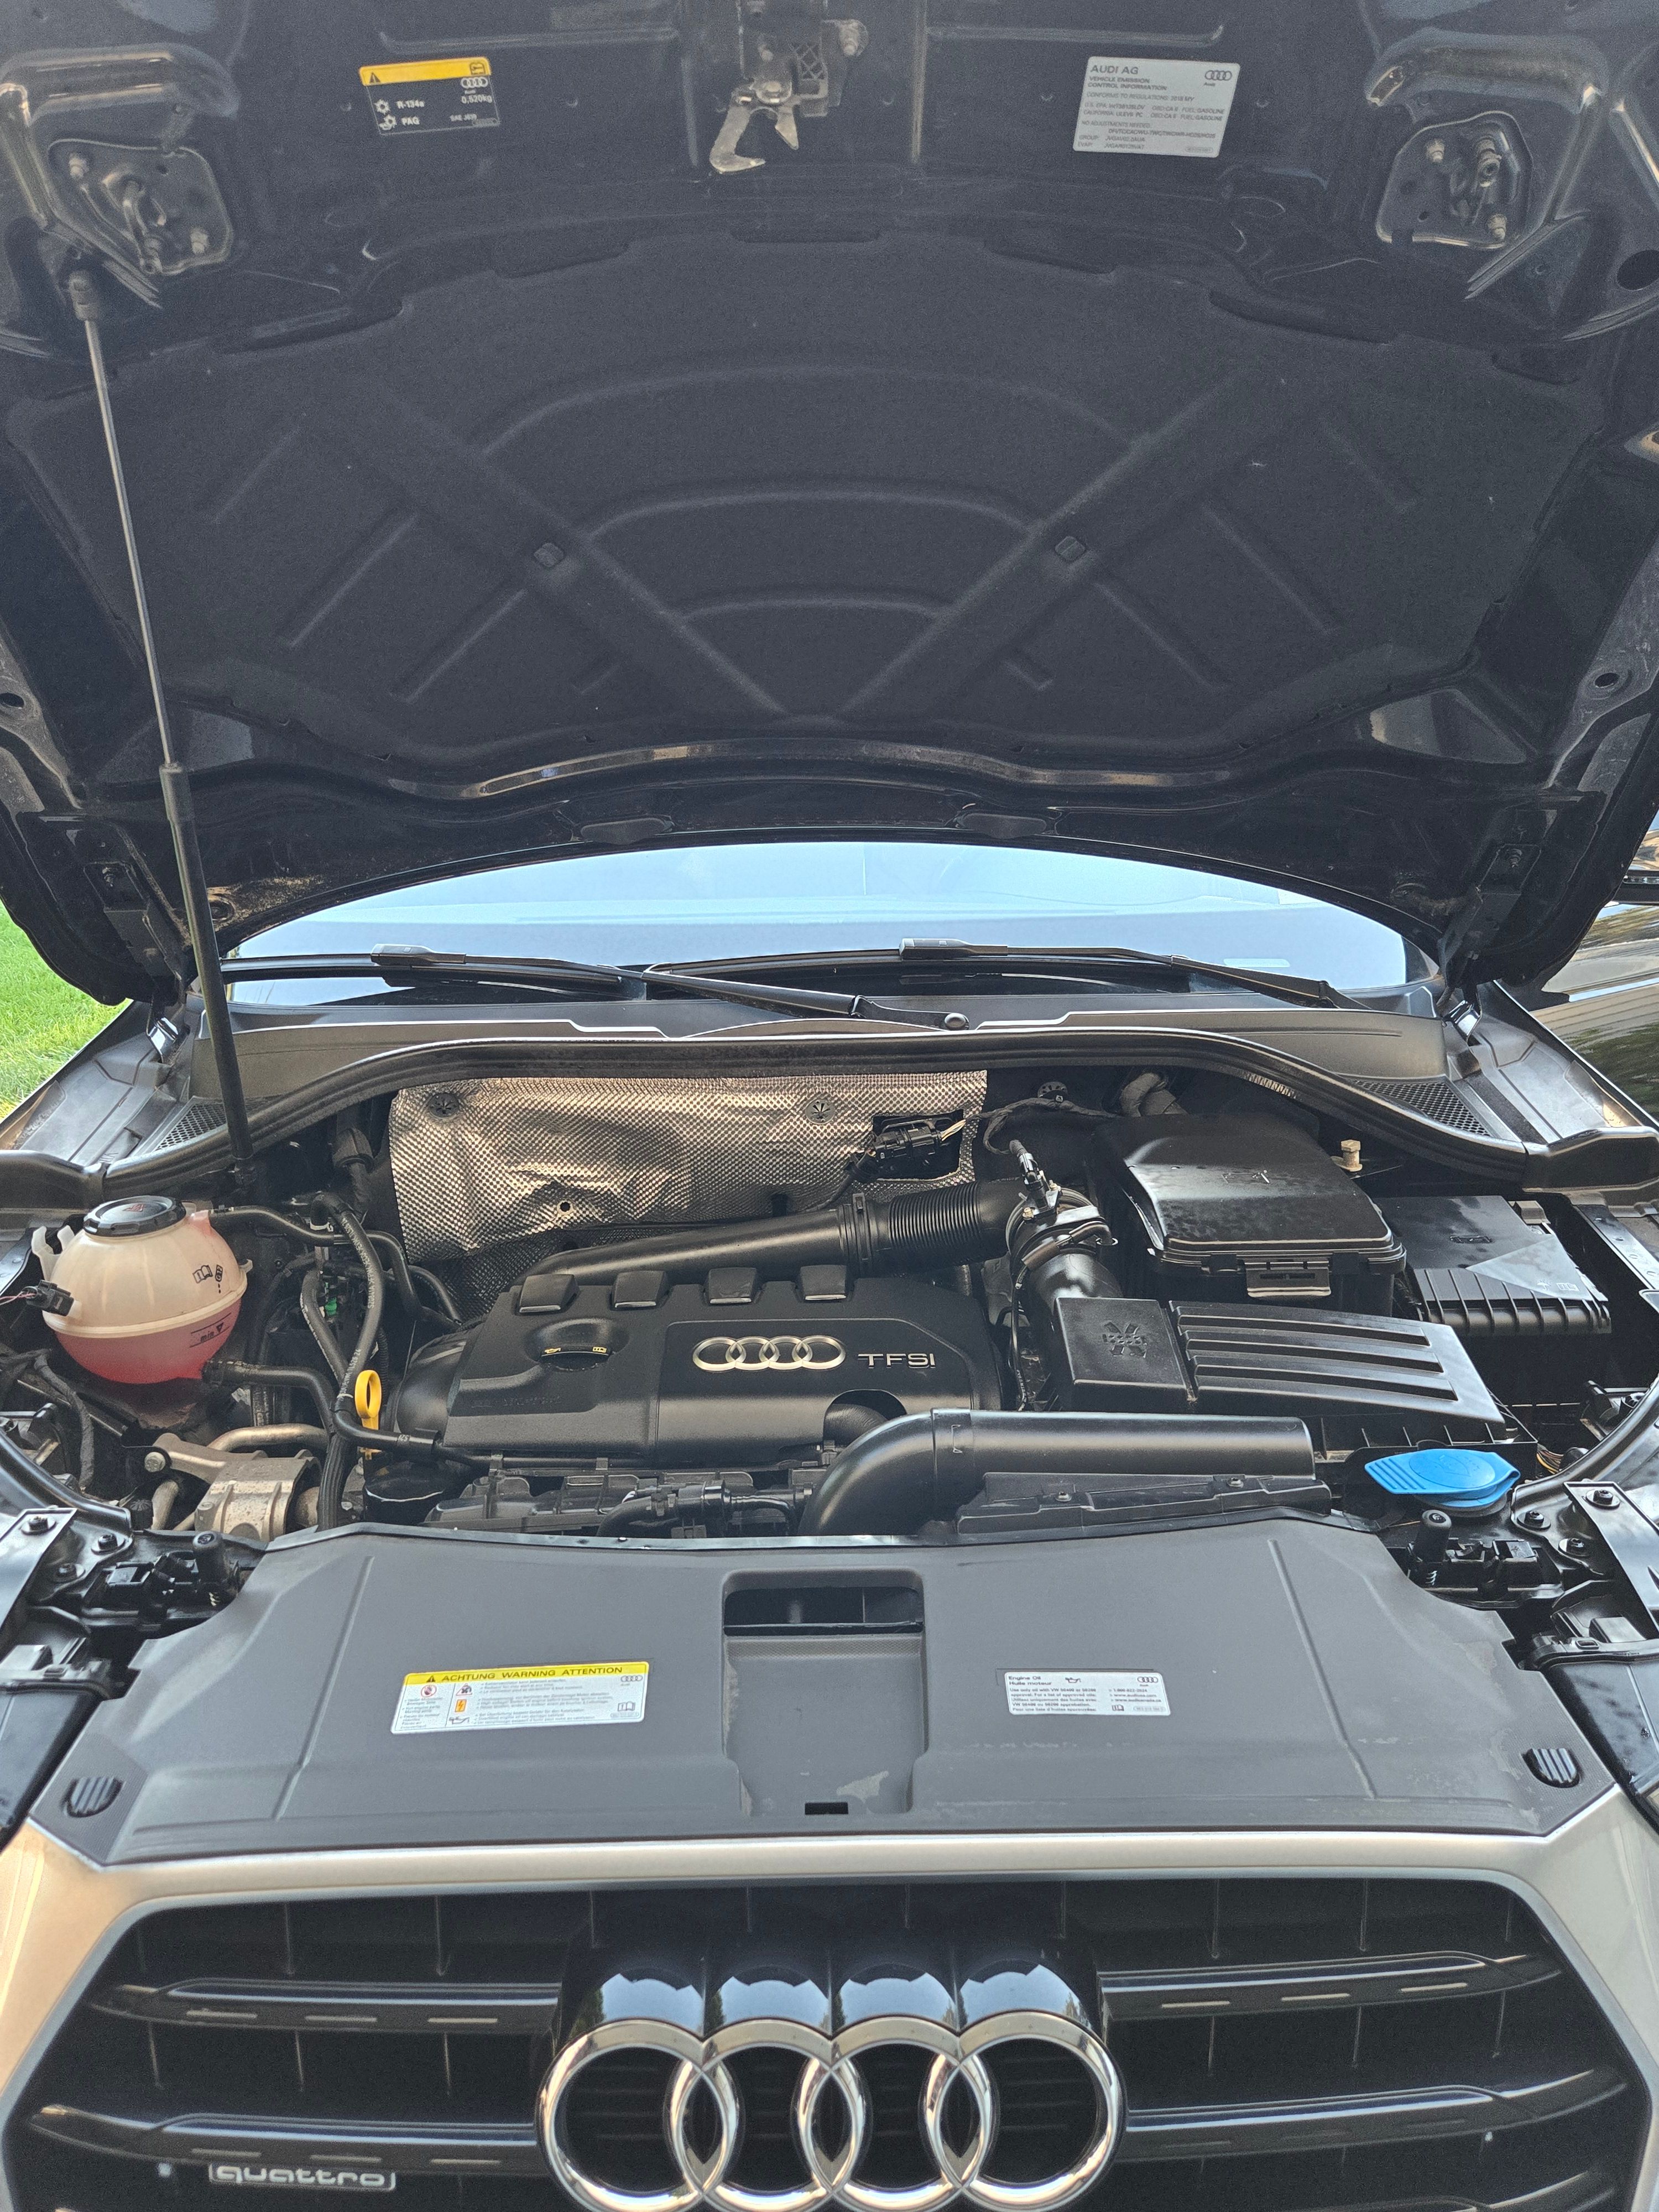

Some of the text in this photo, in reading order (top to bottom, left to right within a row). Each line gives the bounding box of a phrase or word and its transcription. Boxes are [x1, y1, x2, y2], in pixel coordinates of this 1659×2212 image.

[1091, 65, 1119, 74] AUDI
[401, 116, 420, 126] PAG
[200, 1331, 215, 1342] min
[858, 1353, 936, 1369] TFSI
[442, 1667, 623, 1682] ACHTUNG WARNING ATTENTION
[217, 2166, 385, 2185] quattro
